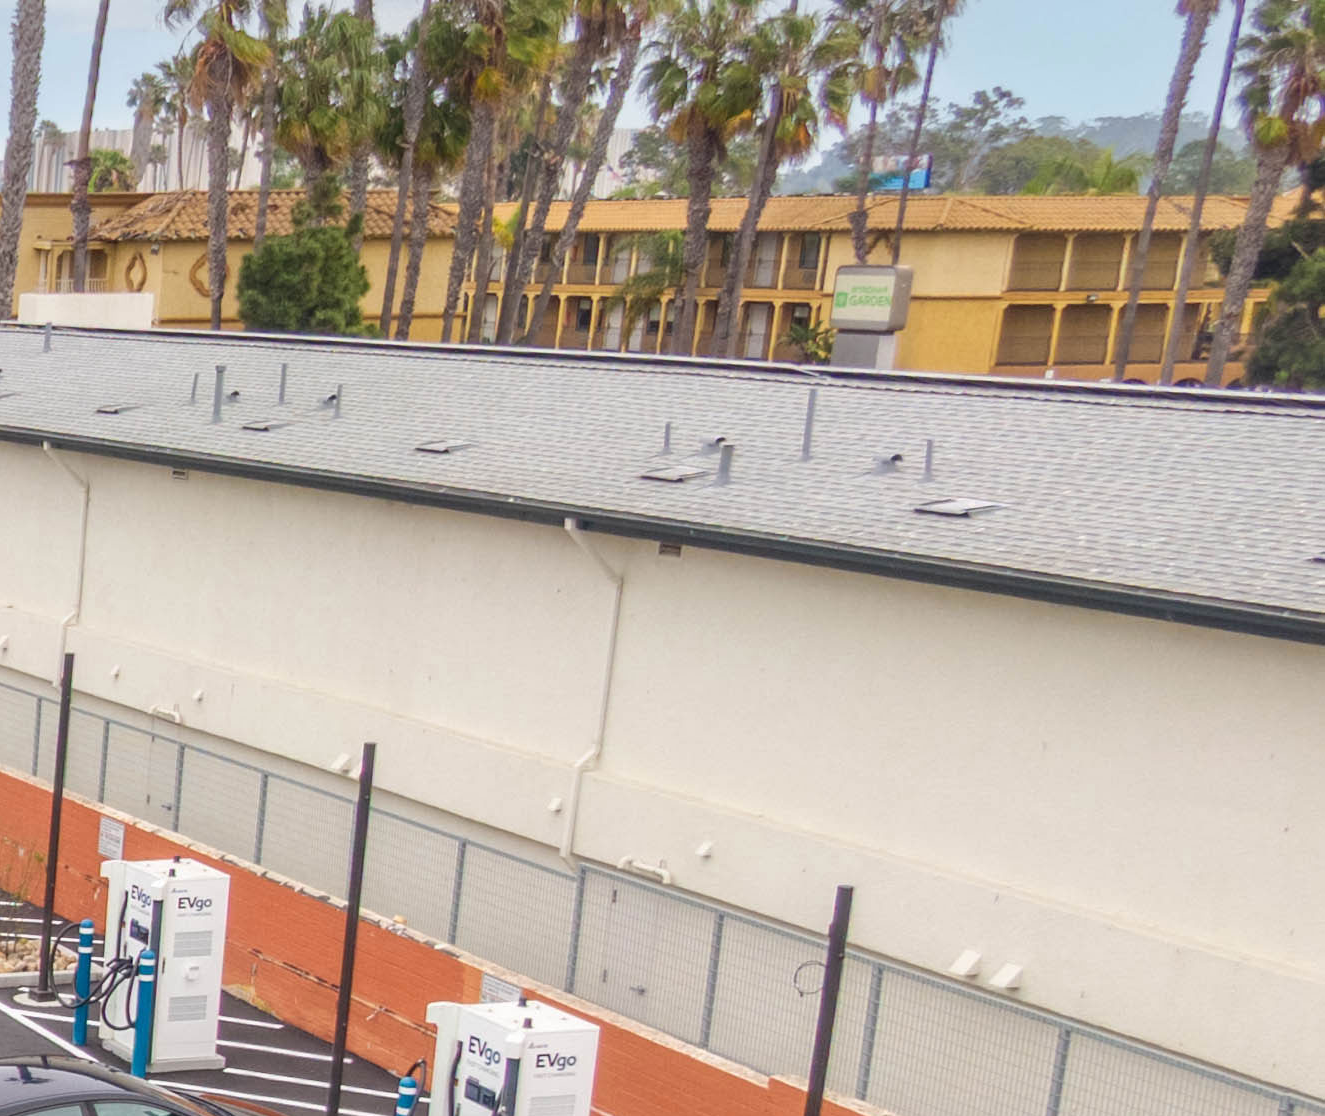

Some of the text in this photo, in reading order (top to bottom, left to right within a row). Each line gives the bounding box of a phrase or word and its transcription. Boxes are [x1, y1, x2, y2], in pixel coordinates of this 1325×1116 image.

[850, 296, 890, 306] GARDEN
[131, 884, 151, 908] EVgo
[178, 896, 212, 911] EVgo
[468, 1035, 501, 1066] EVgo
[536, 1053, 577, 1071] EVgo
